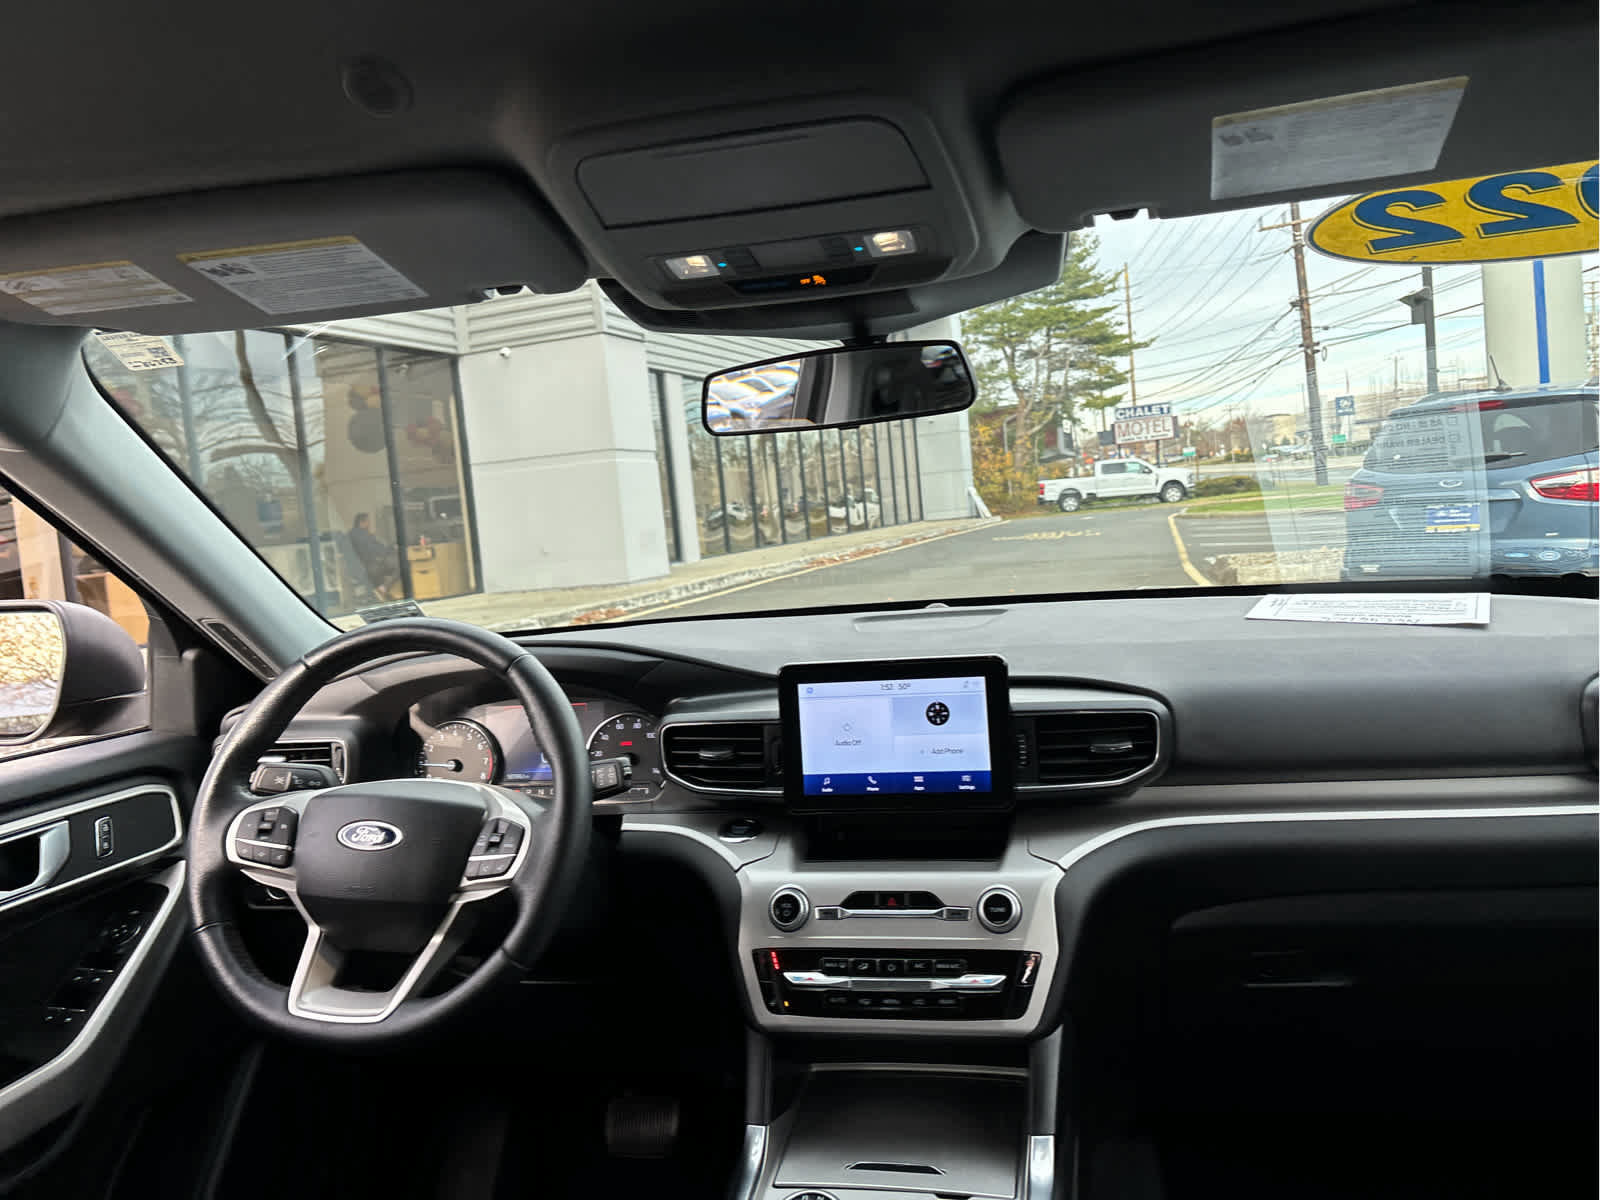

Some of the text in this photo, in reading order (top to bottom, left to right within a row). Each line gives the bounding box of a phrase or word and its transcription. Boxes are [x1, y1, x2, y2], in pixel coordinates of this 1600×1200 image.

[1116, 404, 1169, 419] CHALET
[1117, 417, 1170, 437] MOTEL
[352, 826, 386, 846] Ford
